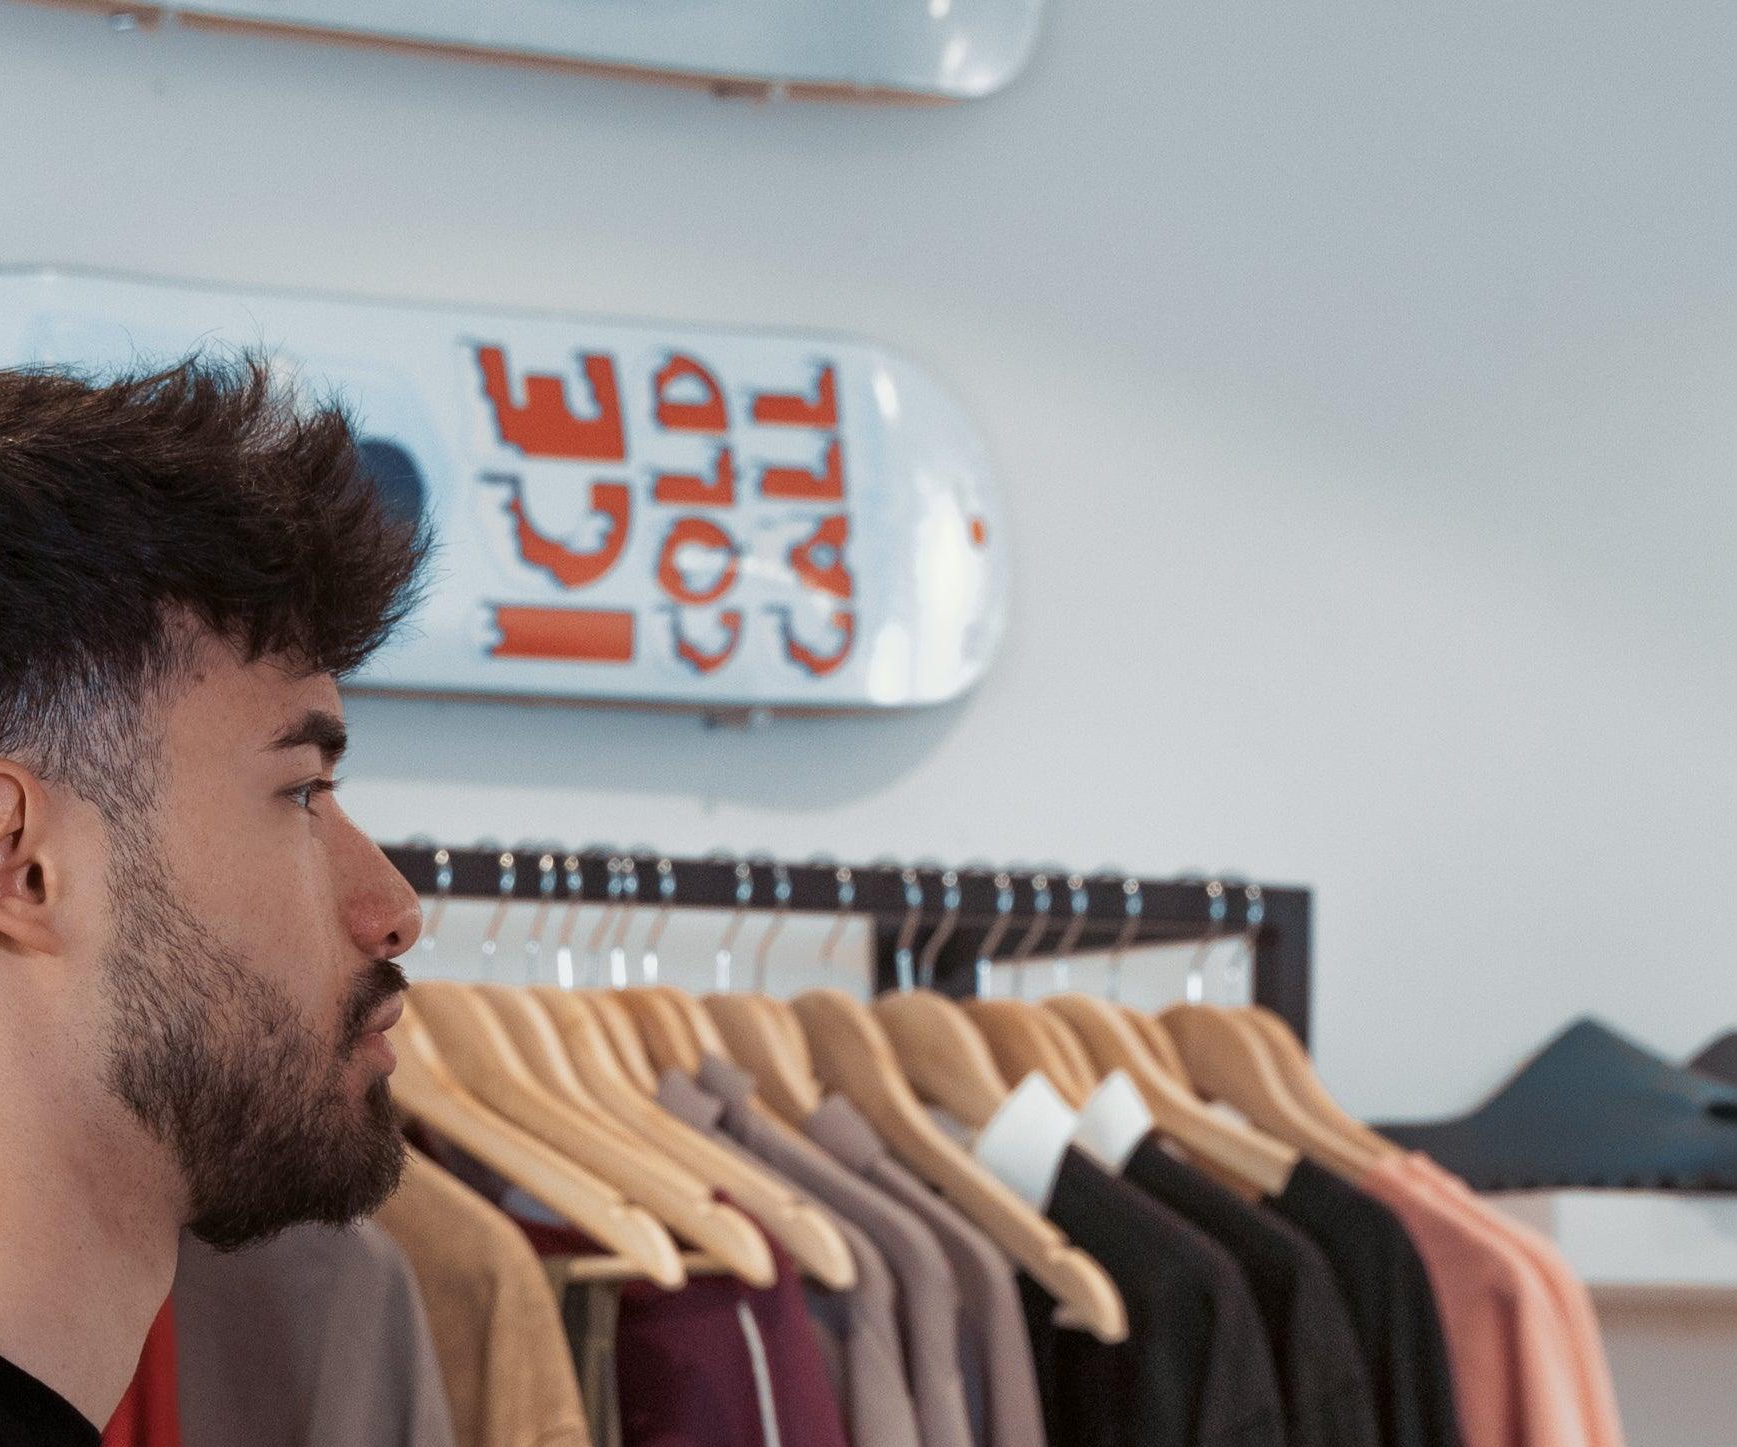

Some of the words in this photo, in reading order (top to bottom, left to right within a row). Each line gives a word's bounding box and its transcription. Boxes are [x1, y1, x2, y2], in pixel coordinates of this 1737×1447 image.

[475, 343, 634, 665] ICE
[653, 352, 742, 674] COLD
[751, 362, 856, 678] CALL
